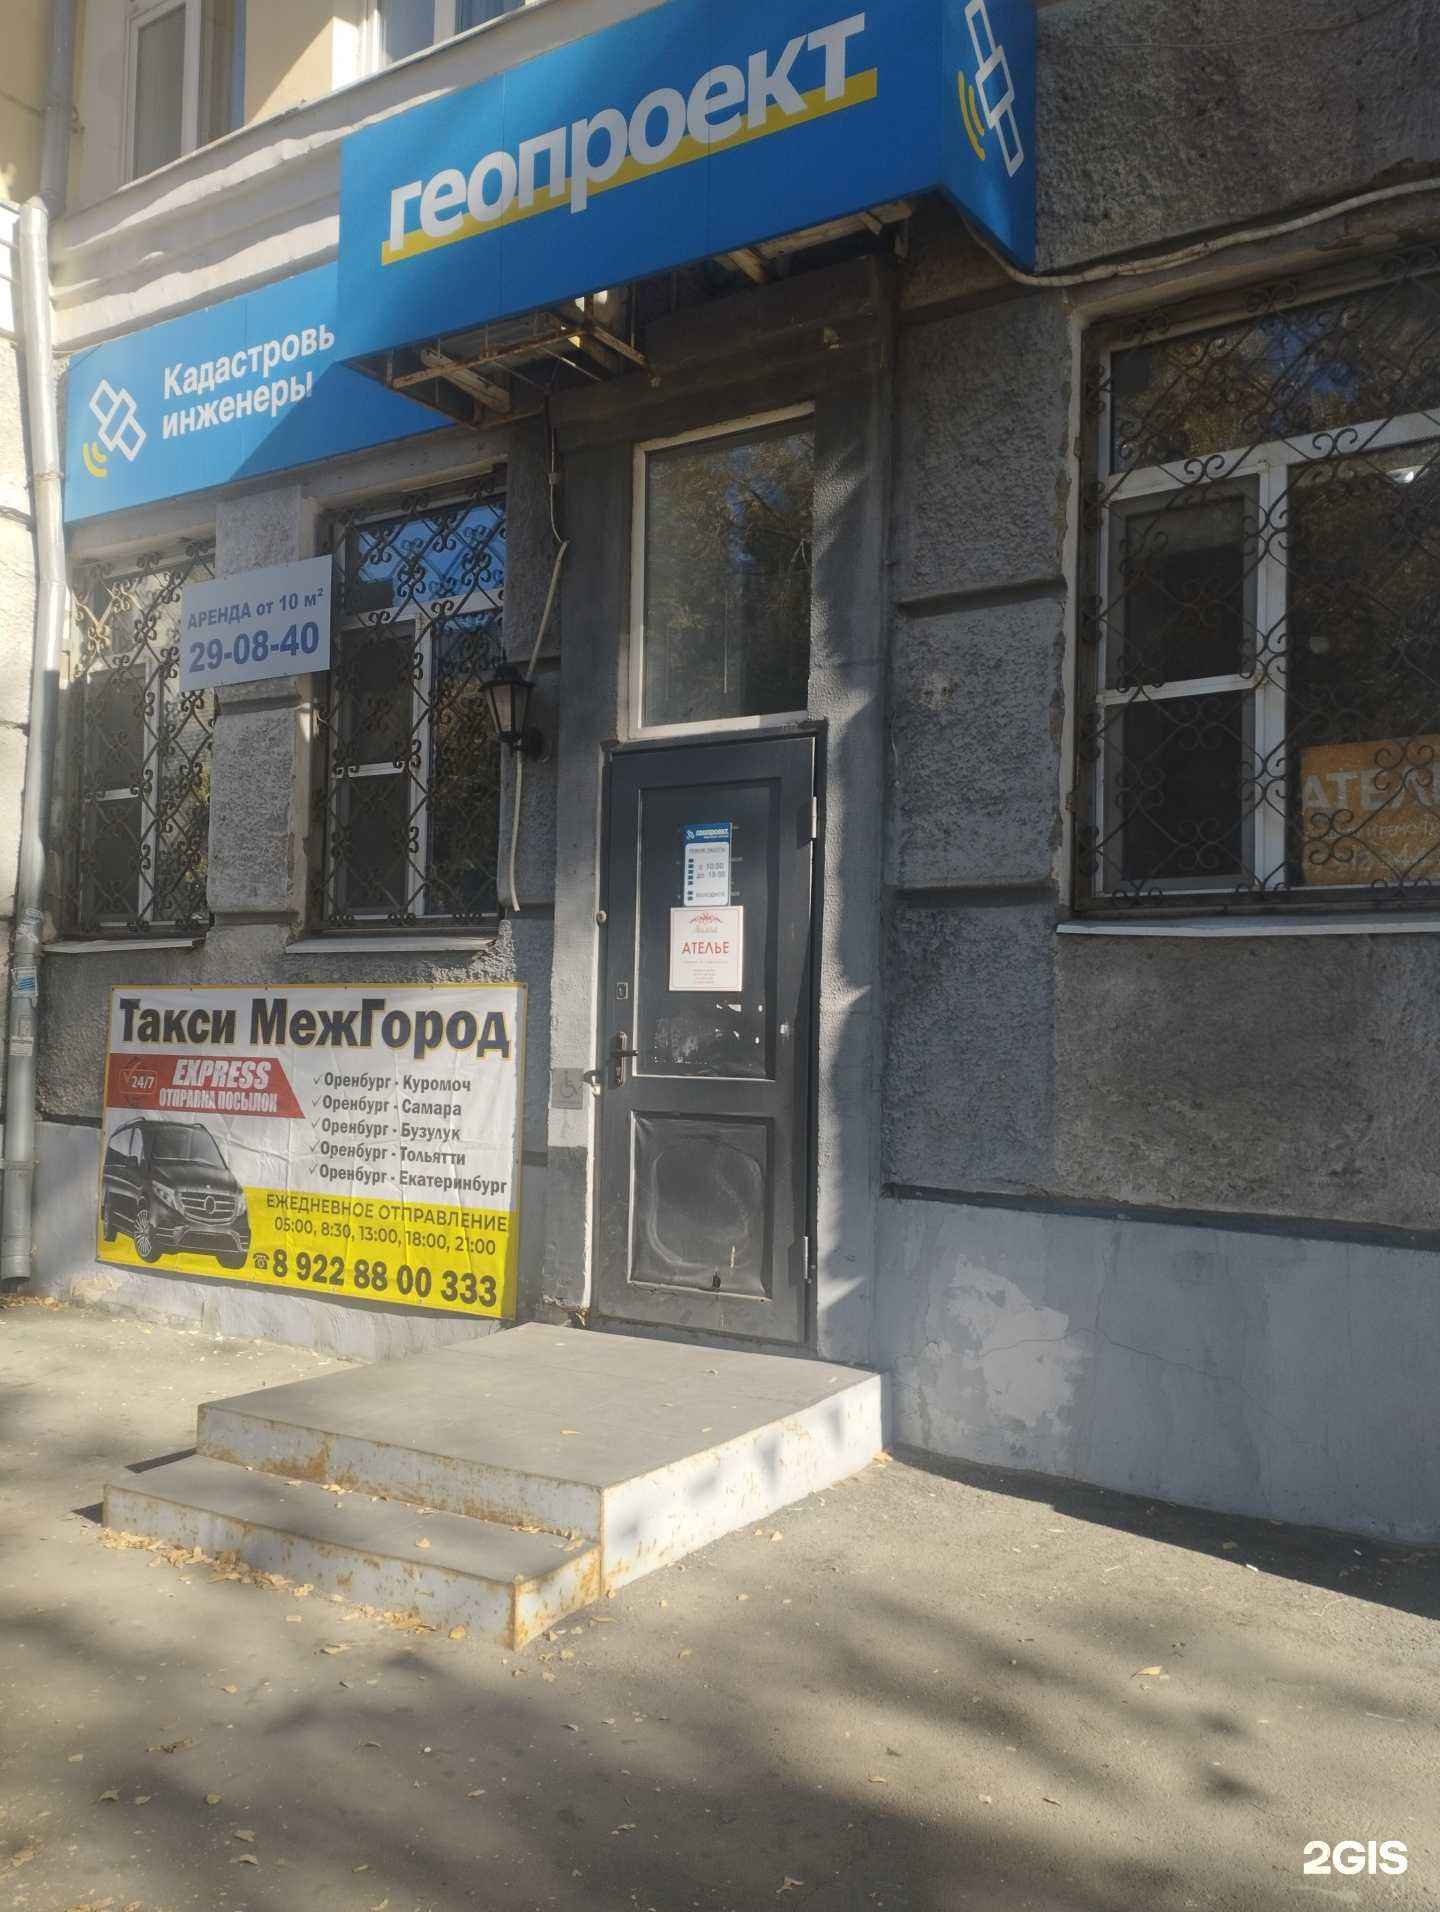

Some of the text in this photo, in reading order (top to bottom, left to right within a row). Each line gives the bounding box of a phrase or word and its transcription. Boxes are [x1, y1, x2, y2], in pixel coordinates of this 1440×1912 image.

[389, 12, 865, 251] геопроект
[162, 371, 313, 440] инженеры
[188, 602, 250, 630] АРЕНДА
[256, 601, 274, 616] от
[279, 593, 299, 611] 10
[189, 621, 319, 673] 29-08-40
[682, 941, 730, 955] АТЕЛЬЕ
[119, 997, 510, 1060] Такси МежГород
[131, 1074, 154, 1089] 24/7
[172, 1059, 272, 1090] EXPRESS
[324, 1072, 391, 1092] Оренбург
[403, 1074, 471, 1093] Куромоч
[322, 1095, 390, 1115] Оренбург
[401, 1099, 462, 1120] Самара
[322, 1118, 389, 1138] Оренбург
[400, 1122, 461, 1142] Бузулук
[320, 1141, 388, 1162] Оренбург
[401, 1146, 466, 1166] Тольятти
[319, 1164, 387, 1185] Оренбург
[400, 1171, 507, 1196] Екатеринбург
[266, 1193, 508, 1232] ЕЖЕДНЕВНОЕ ОТПРАВЛЕНИЕ
[455, 1236, 496, 1256] 21:00
[272, 1248, 497, 1308] 8 922 88 00 333
